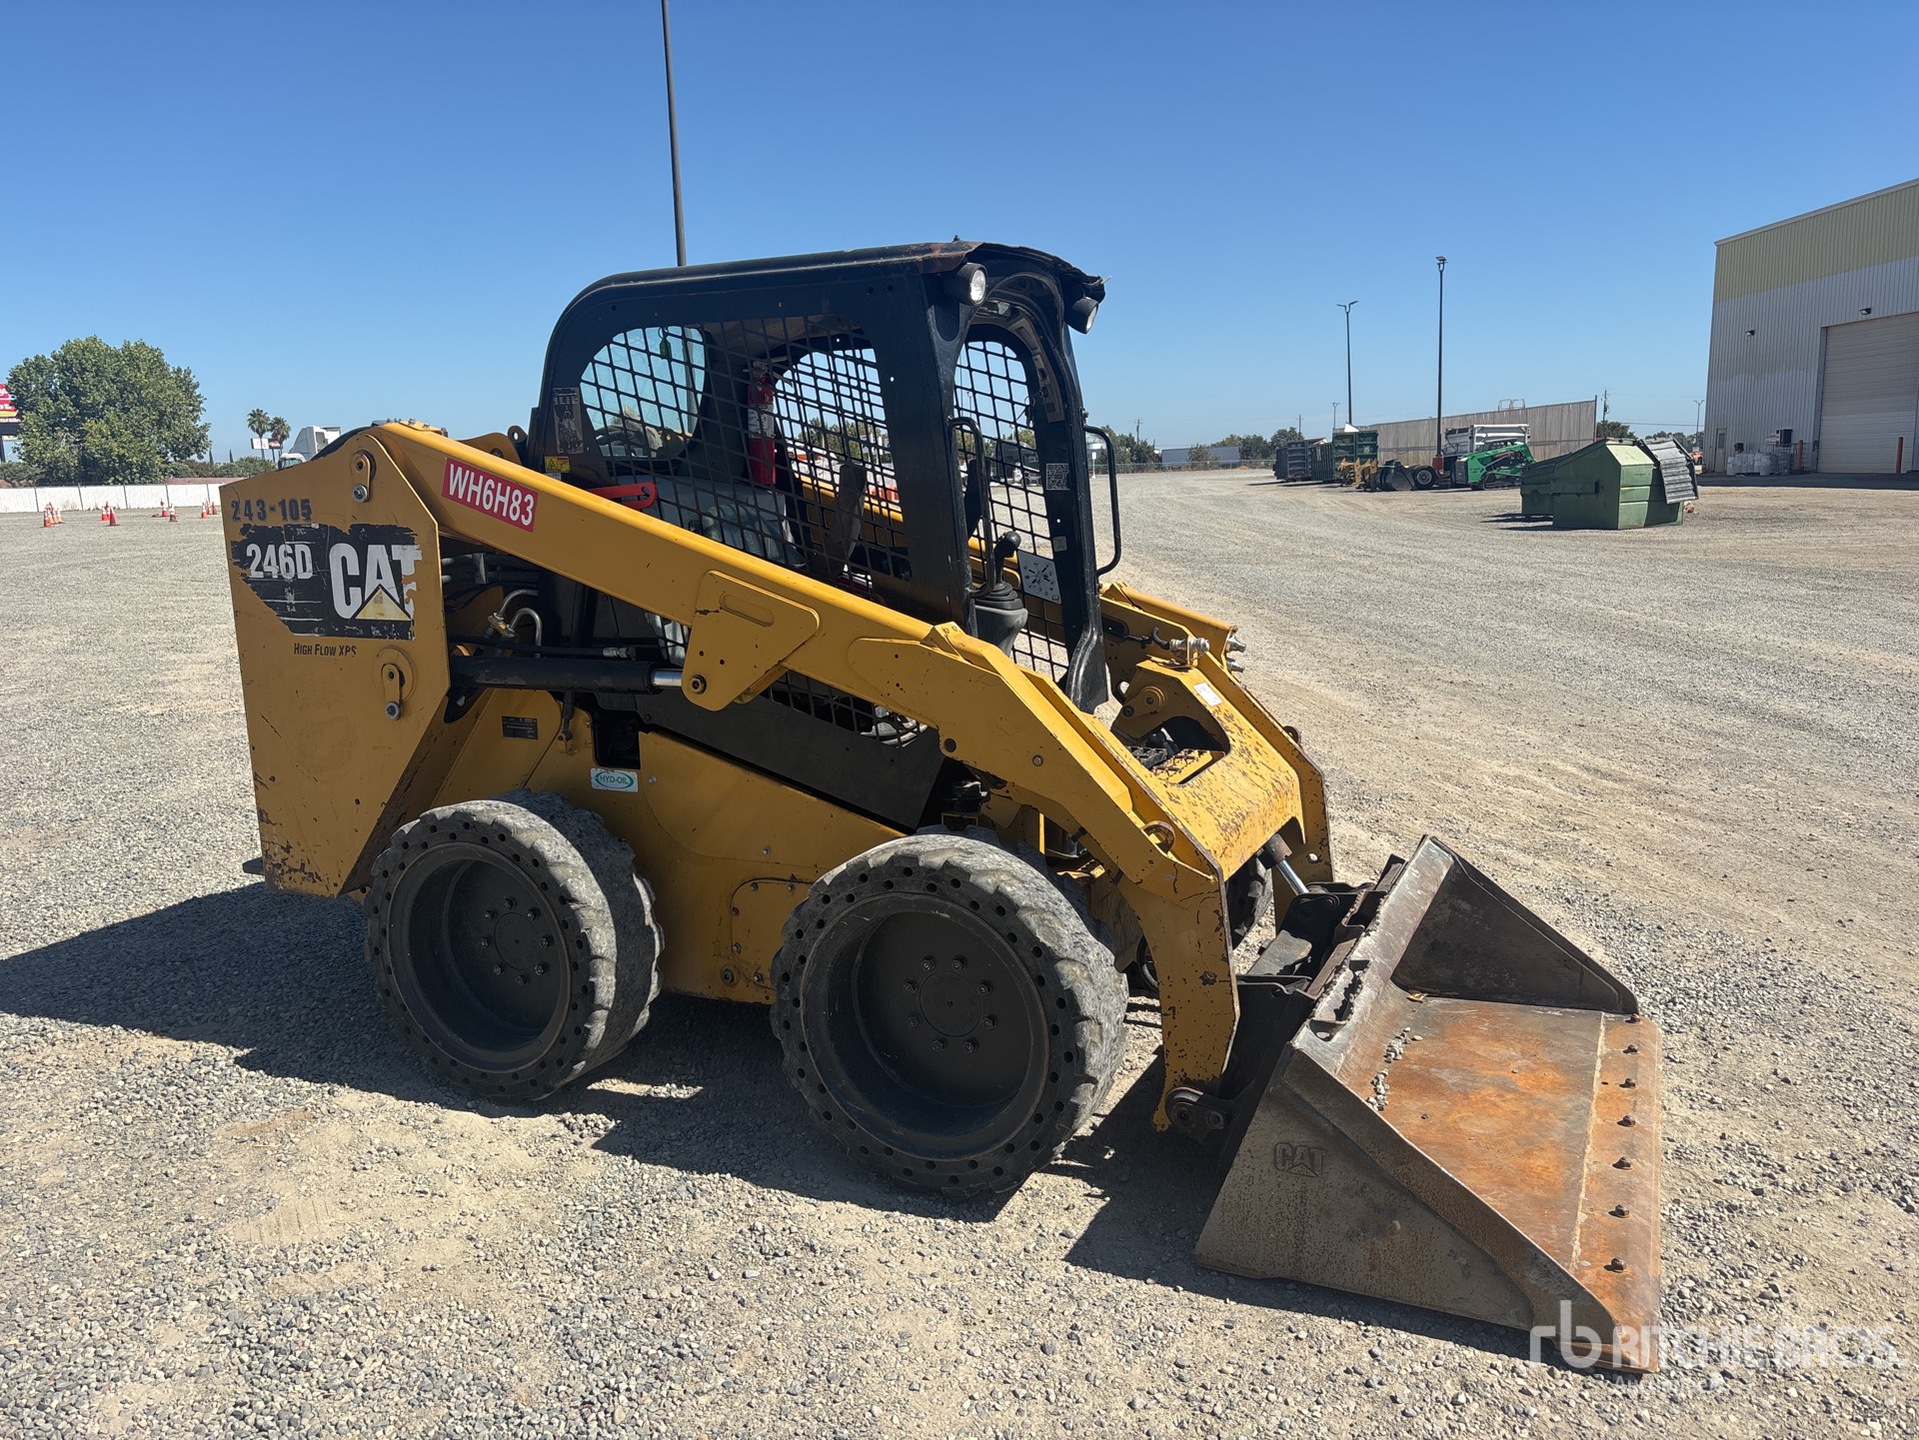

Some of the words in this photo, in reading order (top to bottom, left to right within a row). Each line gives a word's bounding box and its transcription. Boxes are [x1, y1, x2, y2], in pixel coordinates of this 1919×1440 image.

[231, 498, 312, 523] 243-105
[449, 463, 534, 526] WH6H83
[246, 543, 313, 580] 246D
[329, 542, 422, 620] CAT
[338, 645, 357, 658] XPS
[600, 774, 629, 785] HYD-OIL
[1273, 1141, 1327, 1178] CAT
